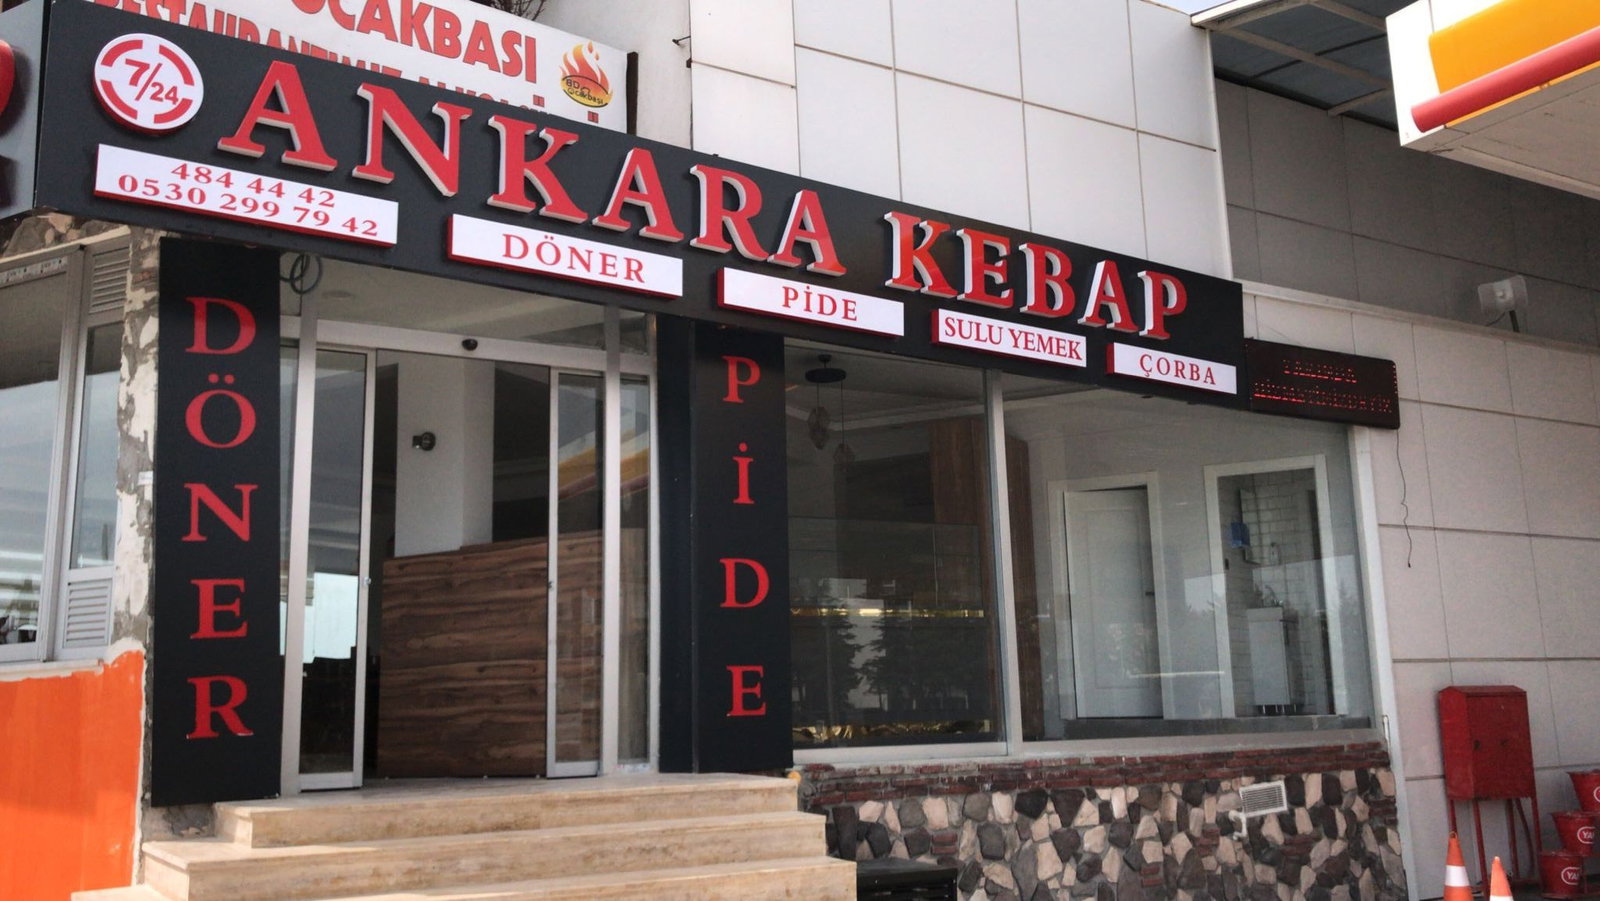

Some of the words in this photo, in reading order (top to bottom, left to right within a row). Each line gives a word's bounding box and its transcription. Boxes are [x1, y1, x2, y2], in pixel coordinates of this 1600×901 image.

[290, 0, 537, 84] CAKBASI
[125, 58, 179, 105] 7/24
[117, 174, 207, 205] 0530
[219, 193, 280, 218] 299
[293, 206, 330, 227] 79
[341, 217, 378, 237] 42
[171, 162, 234, 189] 484
[246, 177, 286, 199] 44
[297, 187, 336, 208] 42
[217, 60, 847, 278] ANKARA
[884, 211, 1188, 340] KEBAP
[502, 233, 646, 284] DÖNER
[781, 285, 859, 322] PİDE
[944, 316, 1003, 345] SULU
[1008, 328, 1083, 360] YEMEK
[1139, 353, 1216, 385] ÇORBA
[181, 297, 258, 740] DÖNER
[719, 355, 770, 717] PİDE
